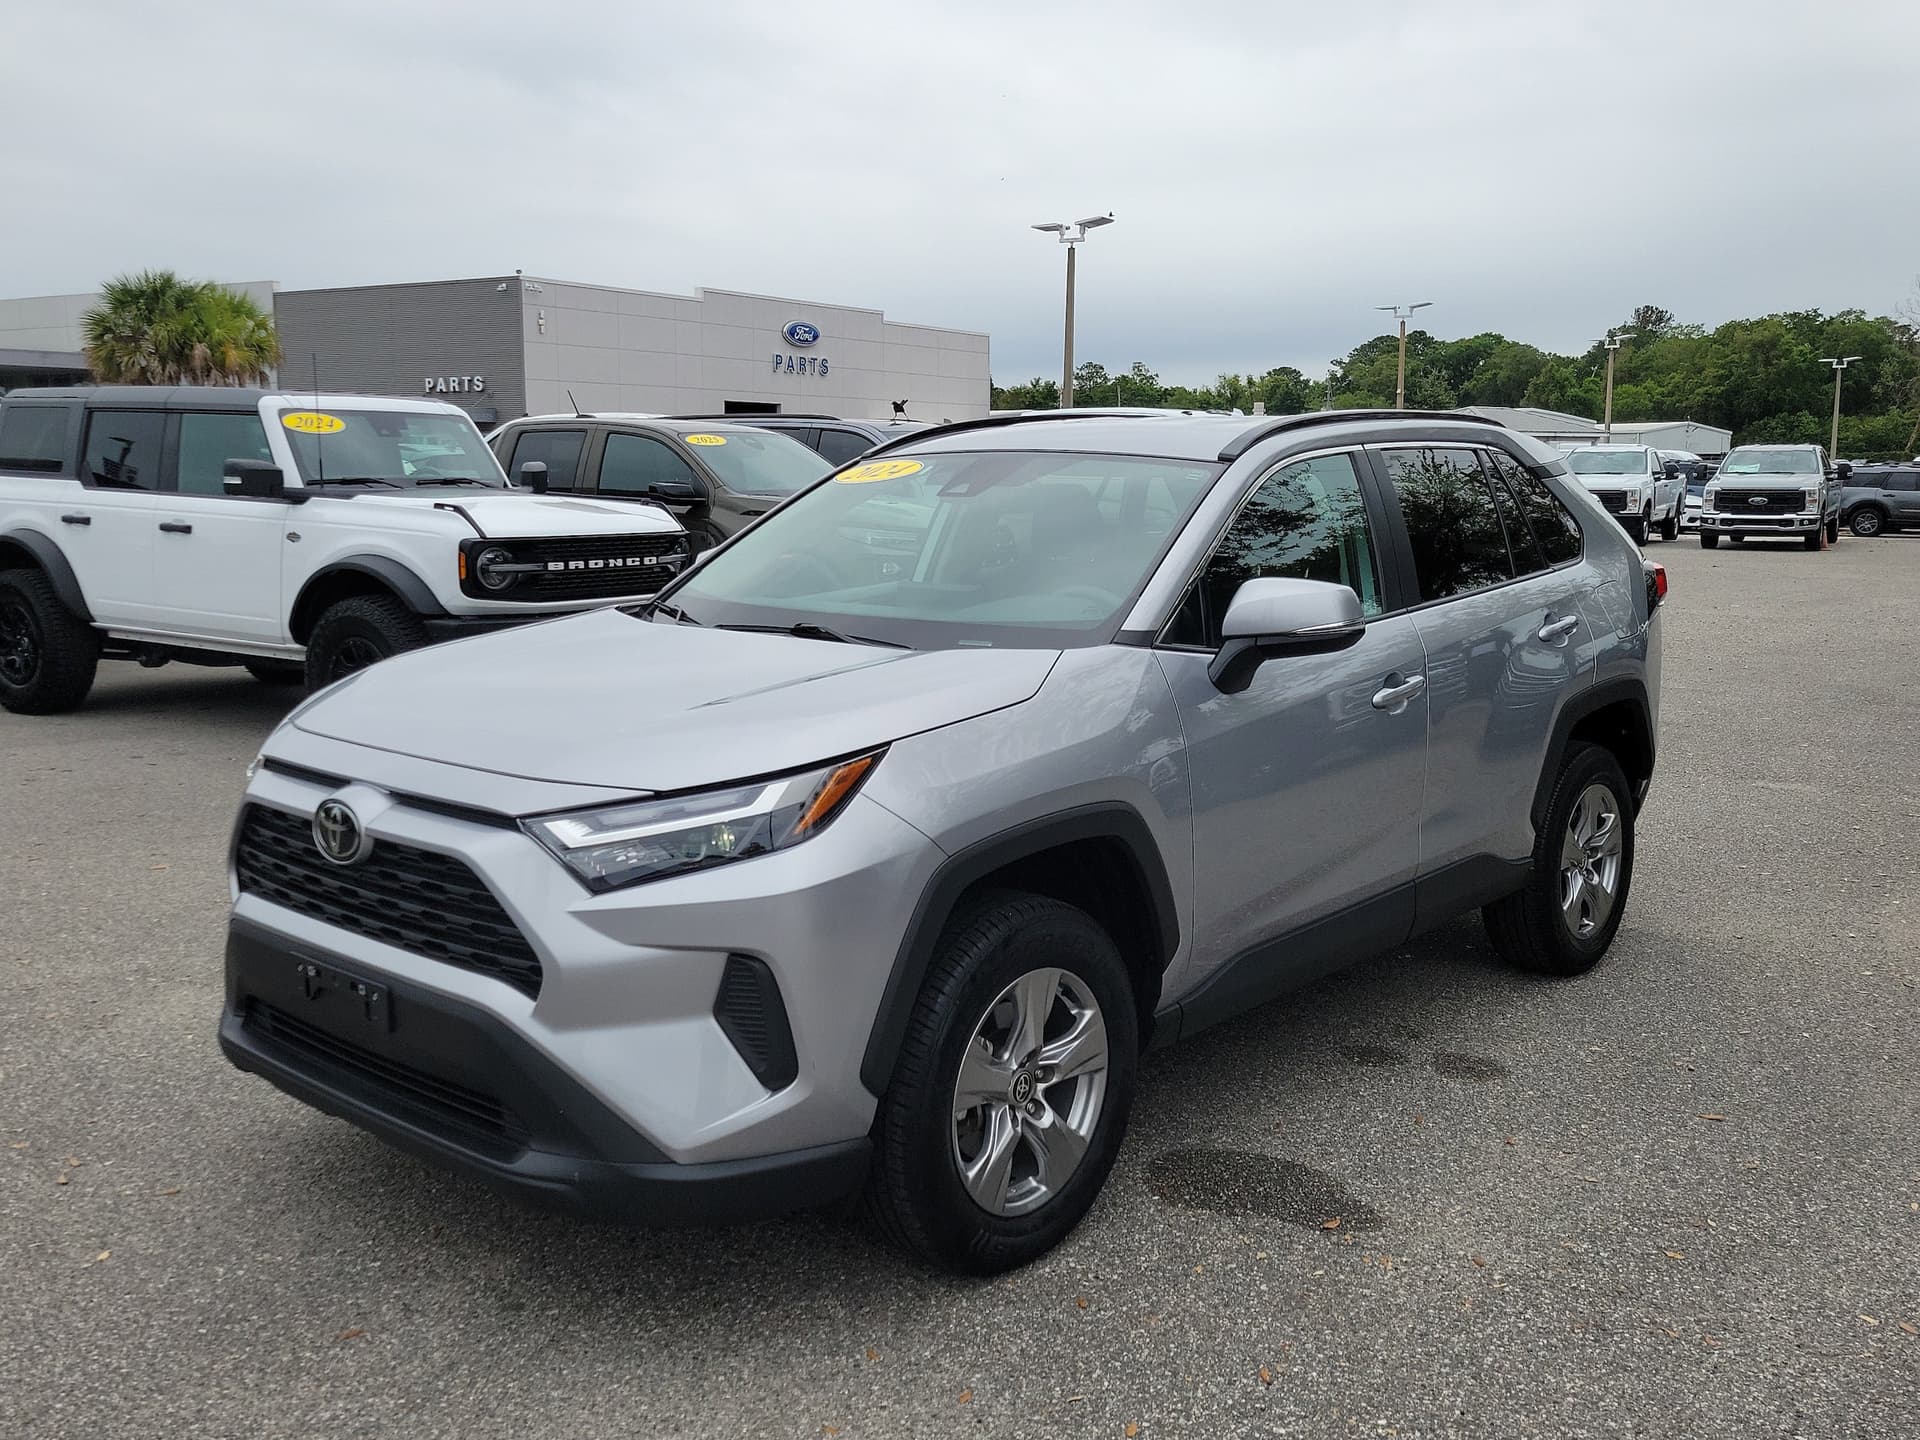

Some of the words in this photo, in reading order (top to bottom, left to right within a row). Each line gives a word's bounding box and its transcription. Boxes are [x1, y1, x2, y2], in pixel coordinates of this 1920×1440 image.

[794, 325, 815, 341] Ford
[773, 353, 829, 376] PARTS
[425, 375, 483, 393] PARTS
[547, 556, 657, 571] BRONCO
